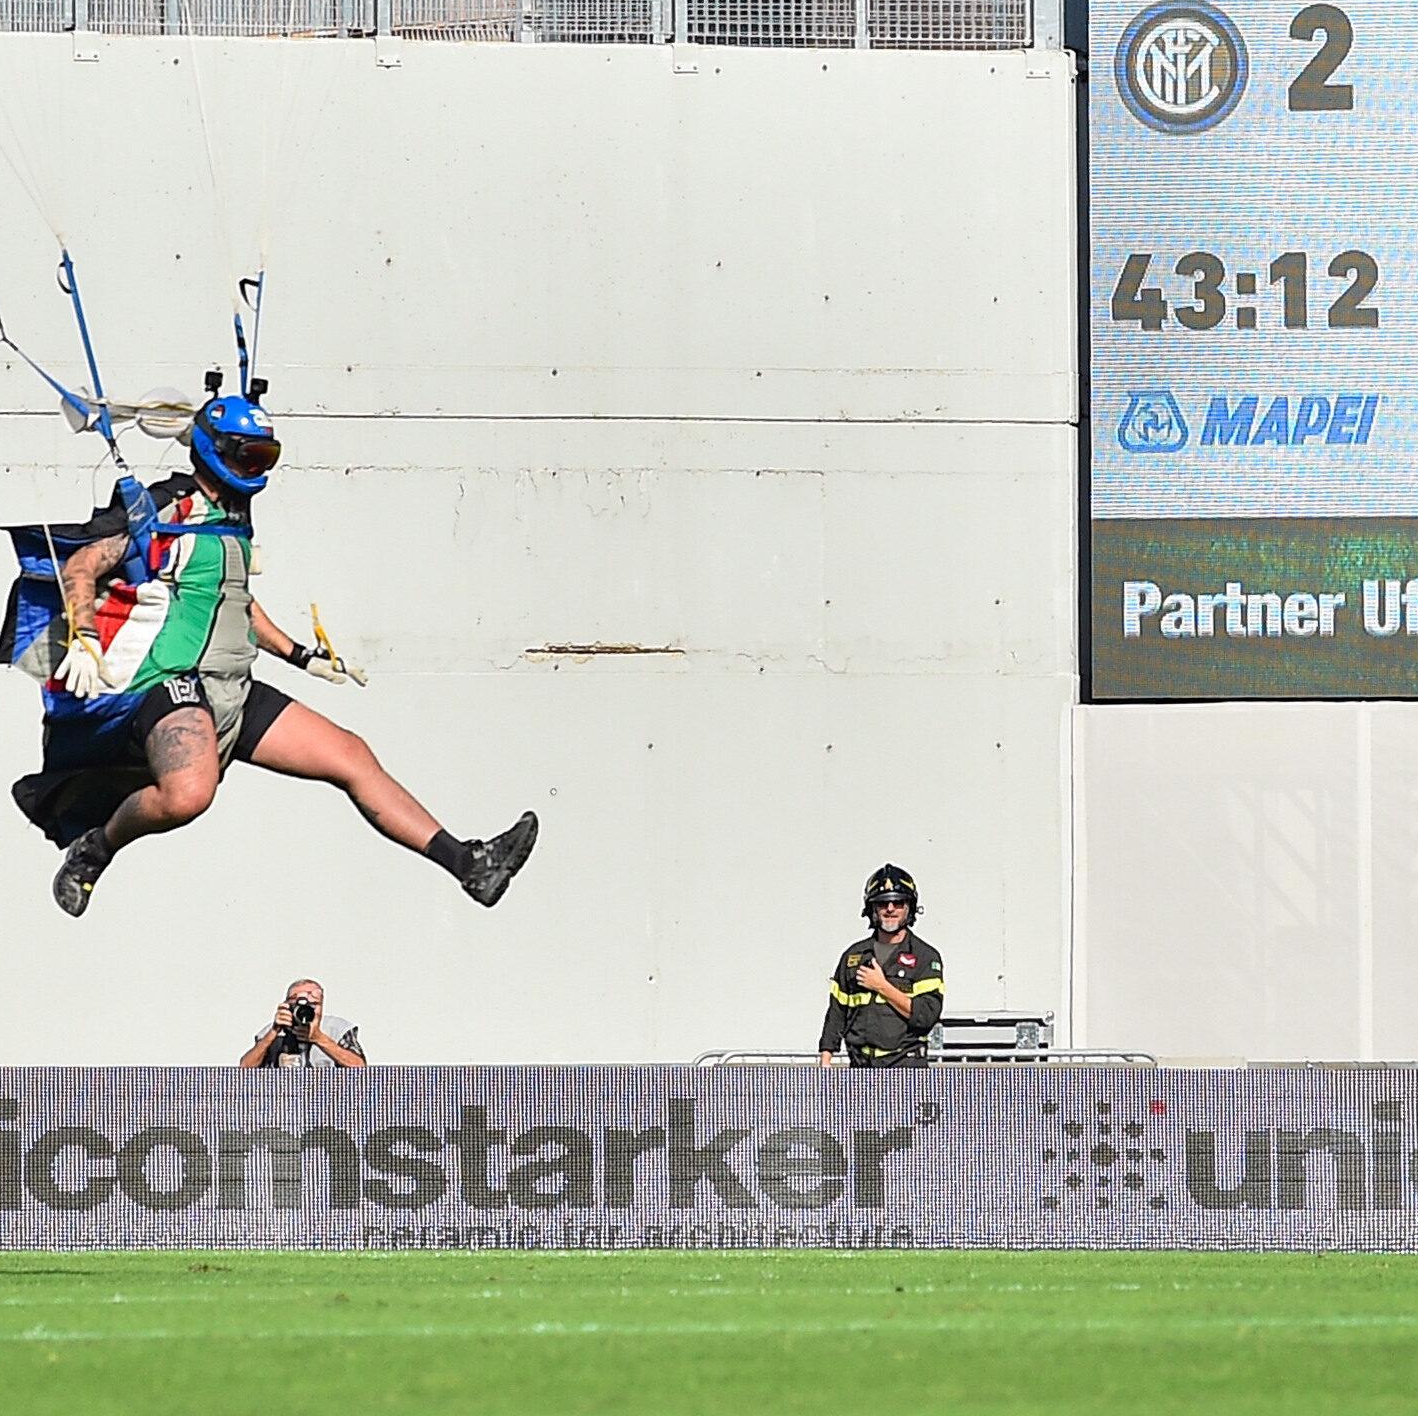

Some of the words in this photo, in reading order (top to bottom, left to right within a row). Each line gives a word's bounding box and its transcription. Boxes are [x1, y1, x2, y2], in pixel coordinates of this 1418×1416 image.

[1287, 2, 1355, 112] 2
[1112, 250, 1379, 331] 43:12
[1200, 393, 1380, 446] MAPEI
[1123, 580, 1346, 639] Partner
